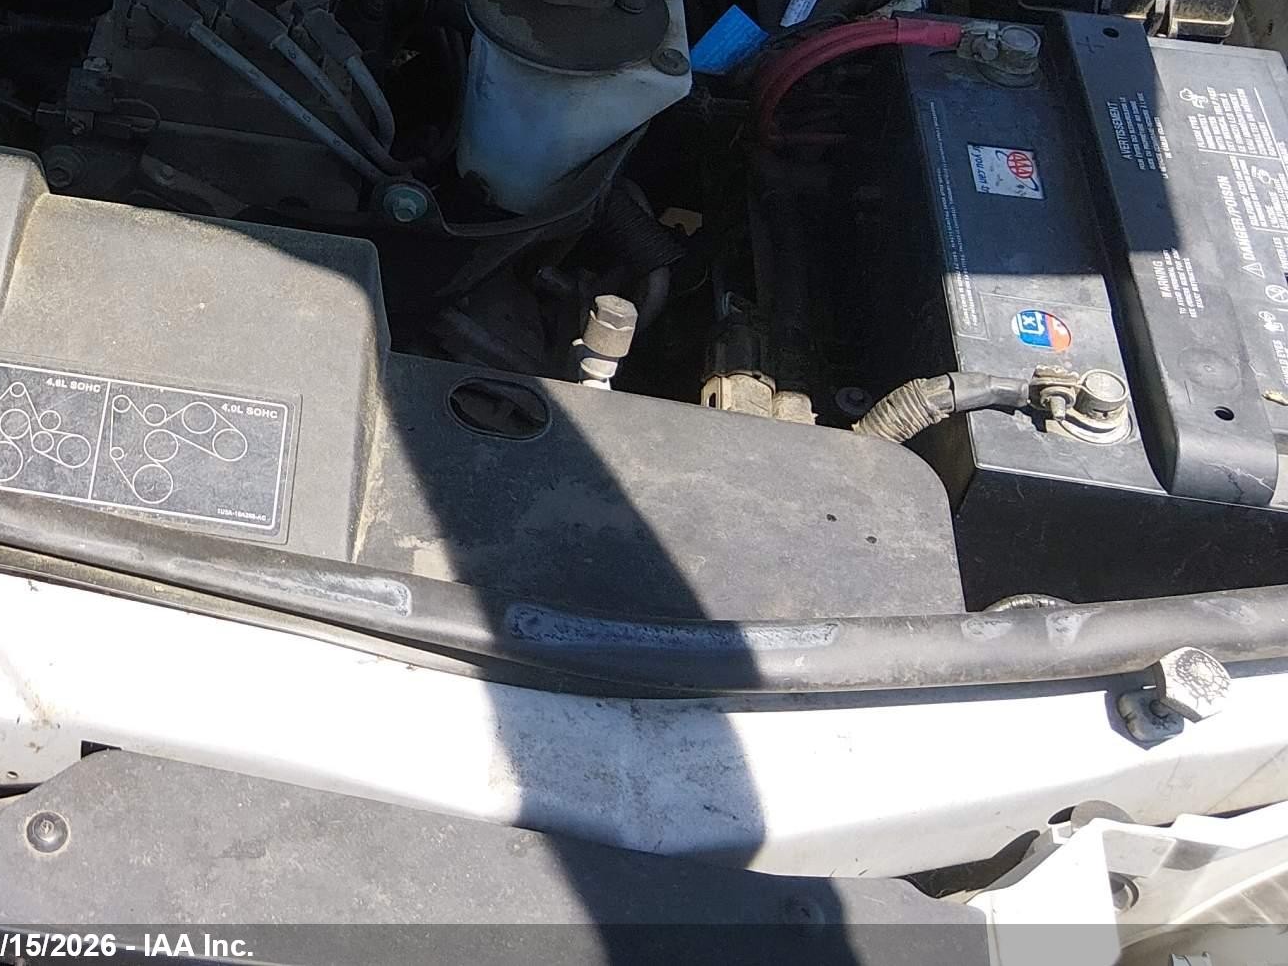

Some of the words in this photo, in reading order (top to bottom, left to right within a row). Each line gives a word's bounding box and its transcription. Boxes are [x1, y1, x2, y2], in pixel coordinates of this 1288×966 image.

[1107, 101, 1132, 160] AVERTISSEMENT
[971, 152, 985, 169] you
[1216, 175, 1256, 261] DANGER/POISON
[1152, 260, 1172, 298] WARNING
[70, 380, 101, 393] SOHC
[221, 403, 244, 414] 4.0L
[246, 406, 278, 419] SOHC
